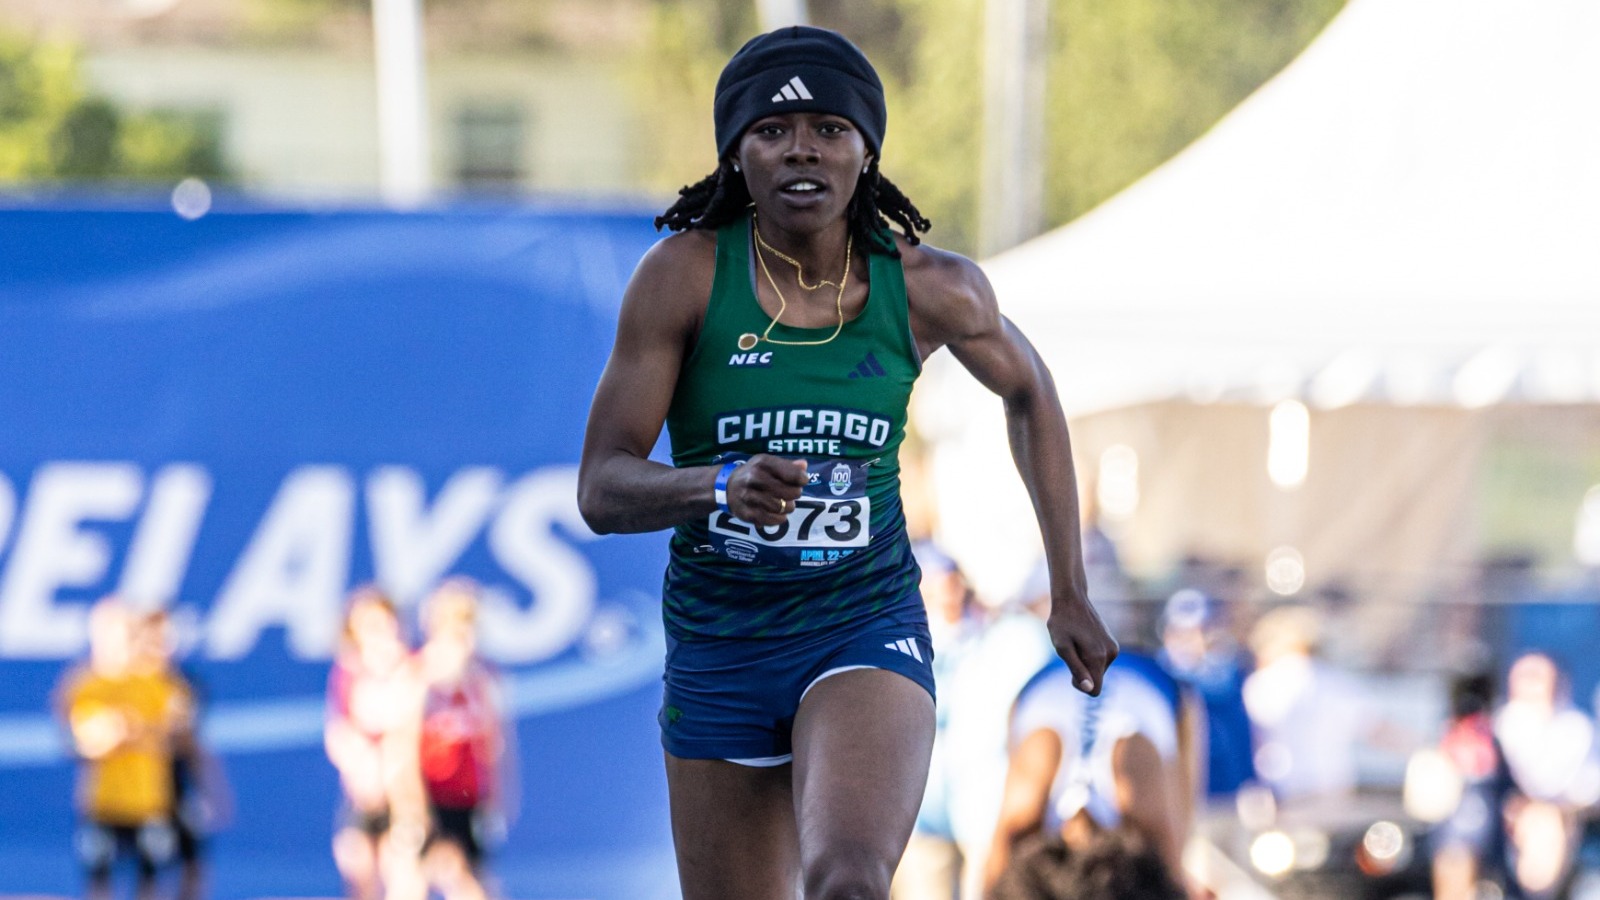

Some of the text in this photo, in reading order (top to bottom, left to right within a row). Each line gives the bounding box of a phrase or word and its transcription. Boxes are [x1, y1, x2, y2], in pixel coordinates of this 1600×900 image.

[728, 352, 773, 365] NEC
[717, 409, 890, 447] CHICAGO
[768, 439, 841, 455] STATE
[833, 471, 849, 483] 100
[0, 460, 600, 664] ELAYS
[800, 549, 825, 561] APRIL
